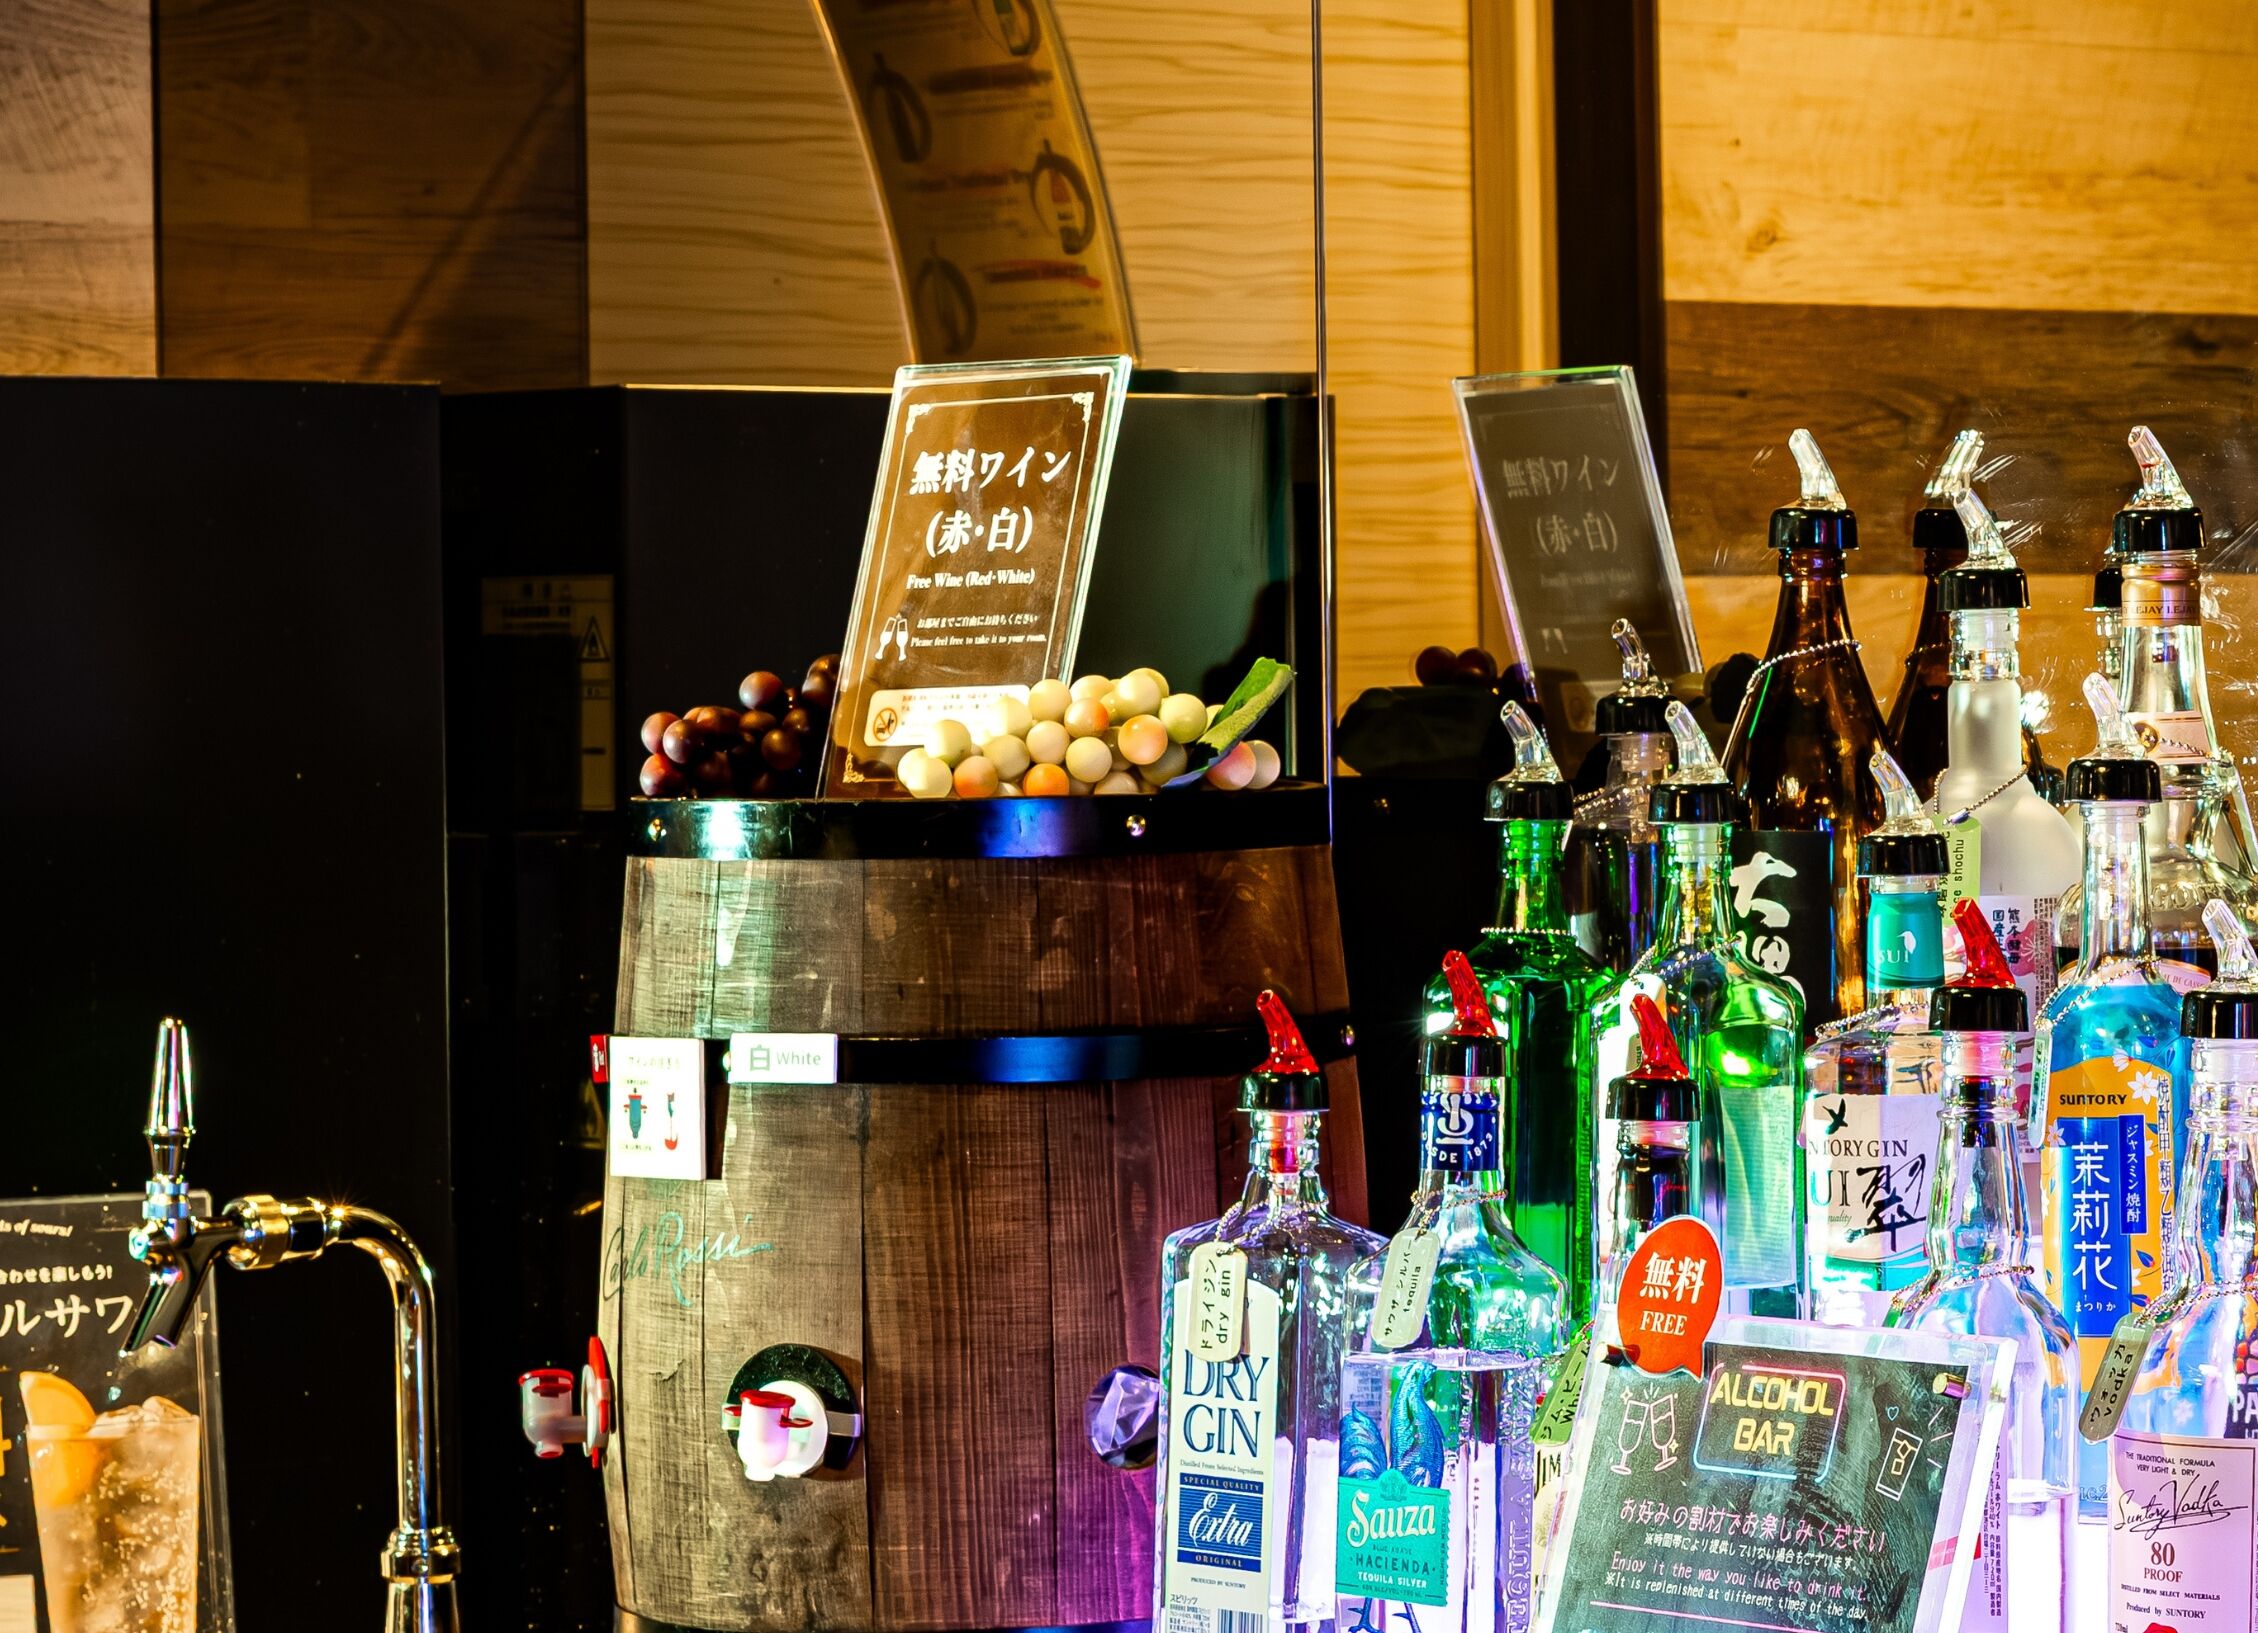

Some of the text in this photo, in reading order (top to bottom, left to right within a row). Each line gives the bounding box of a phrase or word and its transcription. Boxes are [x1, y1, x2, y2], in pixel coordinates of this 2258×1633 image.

[909, 447, 1071, 494] 無料ワイン
[1503, 454, 1619, 499] 無料ワイン
[906, 574, 932, 589] Free
[935, 573, 963, 587] Wine
[911, 637, 933, 647] Please
[934, 636, 947, 646] feel
[949, 636, 964, 645] free
[1954, 839, 1965, 882] shochu
[750, 1044, 822, 1071] 白 White
[2059, 1093, 2127, 1106] SUNTORY
[1867, 1139, 1909, 1158] GIN
[2125, 1122, 2142, 1224] ジャスミン焼酎
[14, 1219, 31, 1236] of
[2070, 1141, 2119, 1291] 茉莉花
[1403, 1265, 1421, 1313] tequila
[1639, 1251, 1708, 1304] 無料
[1201, 1258, 1218, 1349] ドライジン
[1216, 1269, 1231, 1344] dry gin
[1384, 1299, 1398, 1337] サウザ
[1639, 1310, 1688, 1336] FREE
[2074, 1300, 2117, 1312] まつりか
[1183, 1350, 1270, 1402] DRY
[1709, 1371, 1835, 1417] ALCOHOL
[2104, 1354, 2133, 1417] vodka
[1183, 1403, 1261, 1458] GIN
[1733, 1417, 1796, 1457] BAR
[2126, 1451, 2216, 1467] THE TRADITIONAL FORMULA
[2136, 1463, 2196, 1477] VERY LIGHT & DRY
[1183, 1476, 1260, 1492] SPECIAL QUALITY
[1188, 1492, 1254, 1547] Extra
[1346, 1488, 1436, 1549] Sauza
[1620, 1497, 1886, 1553] お好みの割材でお楽しみください
[2114, 1489, 2169, 1540] Suntory
[1195, 1554, 1243, 1568] ORIGINAL
[1355, 1553, 1430, 1575] HACIENDA
[2151, 1541, 2175, 1567] 80
[1190, 1576, 1217, 1586] PRODUCED
[1357, 1571, 1427, 1588] TEQUILA SILVER
[1611, 1550, 1867, 1602] Enjoy it the way you like to drink it.
[2121, 1583, 2221, 1601] DISTILLED FROM SELECT MATERIALS
[2144, 1567, 2183, 1583] PROOF
[1631, 1576, 1641, 1590] is
[1645, 1580, 1704, 1598] replenished
[1708, 1587, 1719, 1600] at
[1724, 1588, 1774, 1608] different
[1778, 1597, 1806, 1612] times
[1810, 1600, 1822, 1614] of
[1827, 1600, 1844, 1616] the
[1848, 1605, 1868, 1621] day.
[2126, 1602, 2207, 1620] Produced by SUNTORY
